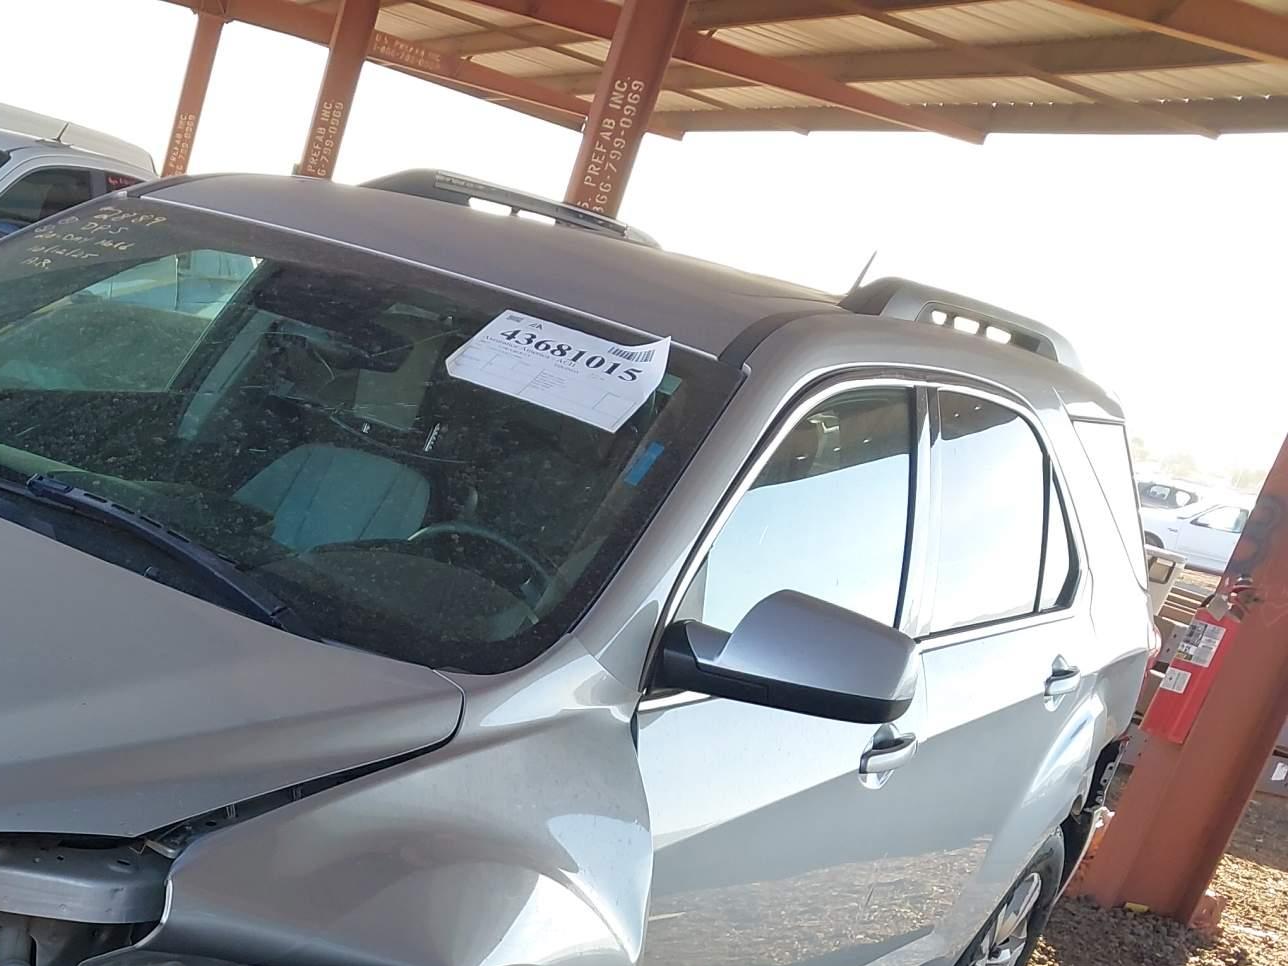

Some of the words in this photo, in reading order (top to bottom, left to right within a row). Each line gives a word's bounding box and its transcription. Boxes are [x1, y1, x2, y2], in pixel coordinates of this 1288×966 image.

[307, 127, 326, 173] PREFAB
[584, 118, 616, 187] PREFAB
[608, 76, 631, 109] INC.
[80, 221, 129, 234] DPS
[499, 328, 644, 383] 43681015
